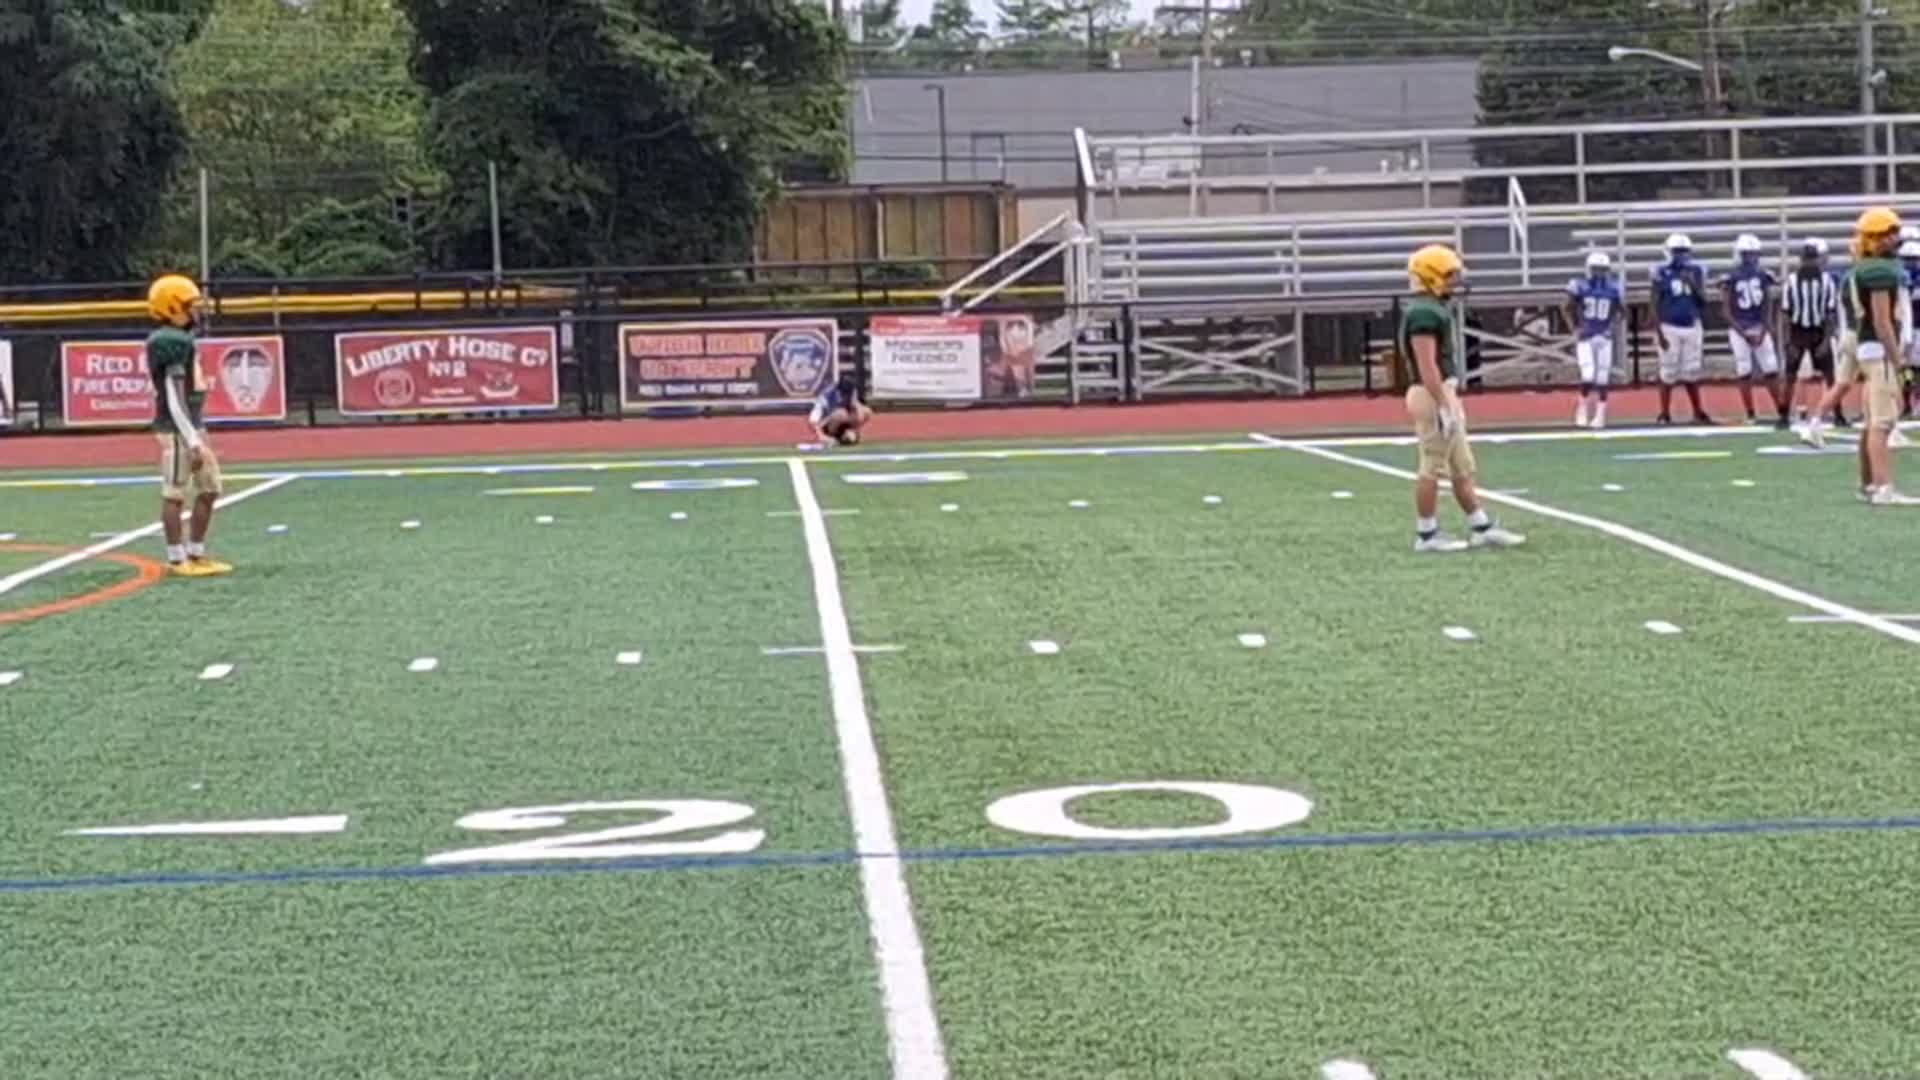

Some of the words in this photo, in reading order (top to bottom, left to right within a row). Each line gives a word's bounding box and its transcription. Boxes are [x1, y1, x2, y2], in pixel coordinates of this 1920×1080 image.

[1735, 278, 1763, 309] 36
[1583, 296, 1610, 320] 30
[86, 353, 133, 375] RED
[345, 338, 439, 377] LIBERTY
[448, 335, 516, 362] HOSE
[891, 352, 958, 364] NEEDED
[72, 377, 109, 395] FIRE
